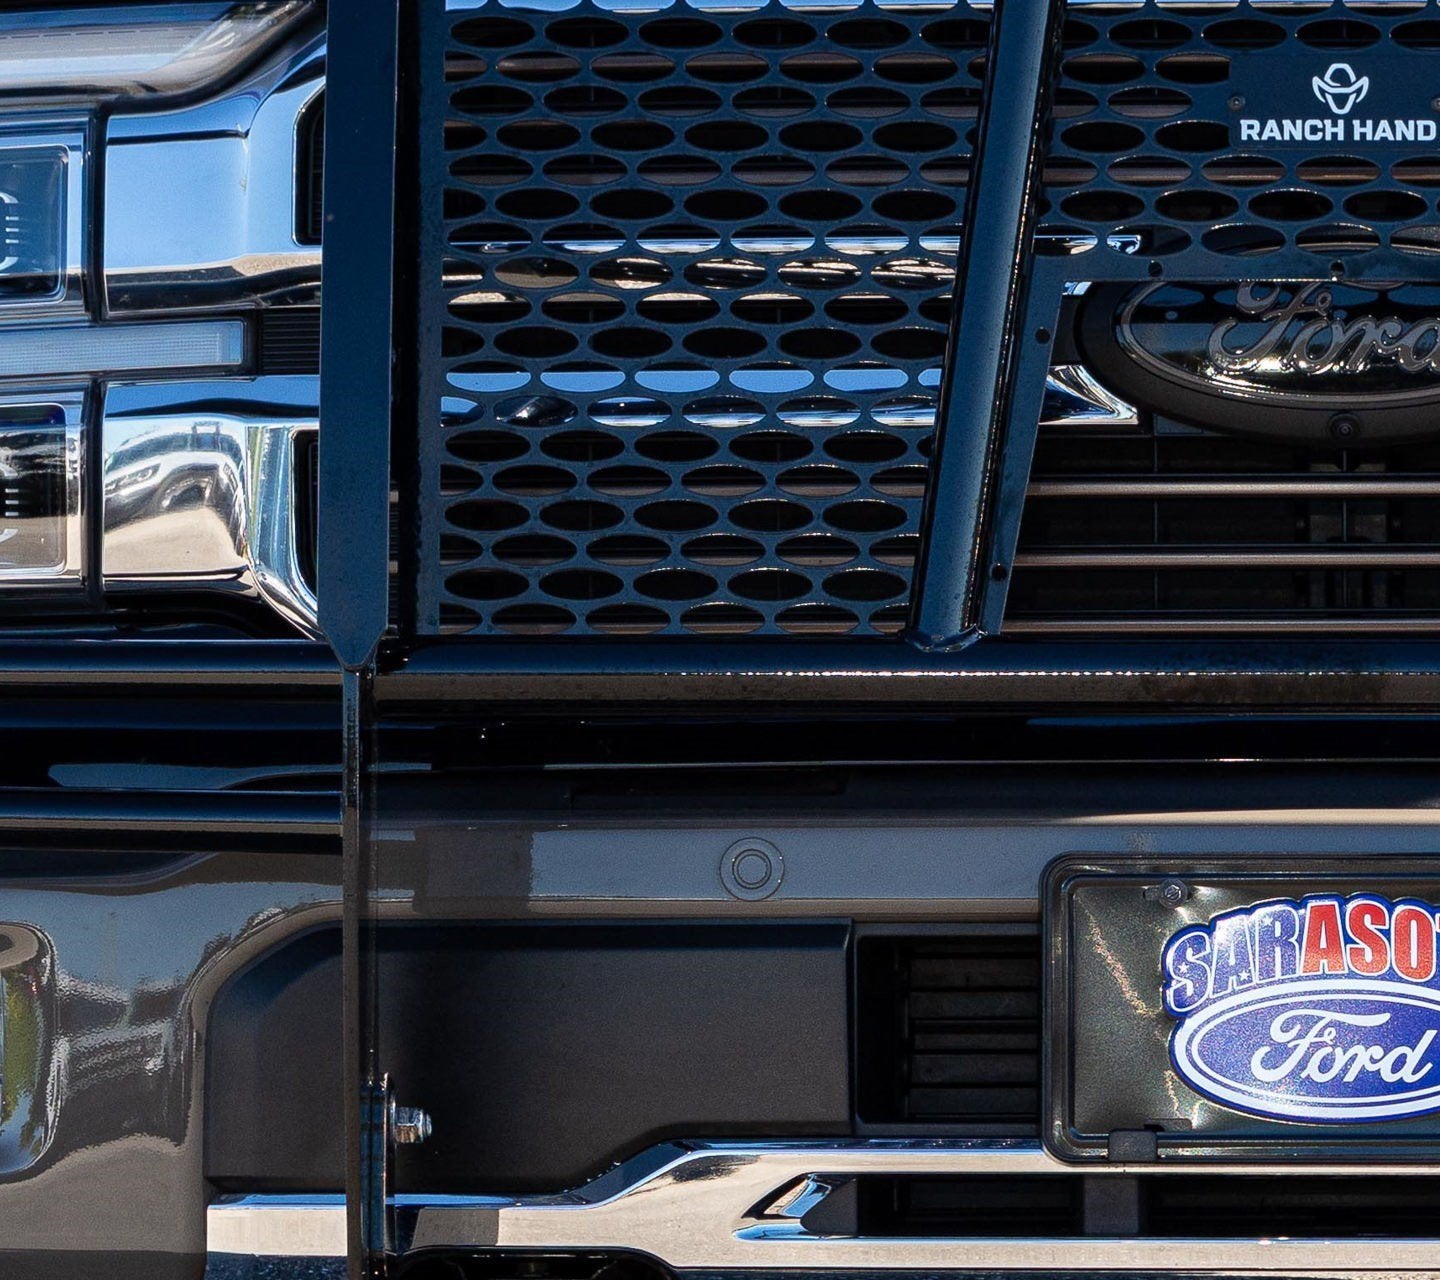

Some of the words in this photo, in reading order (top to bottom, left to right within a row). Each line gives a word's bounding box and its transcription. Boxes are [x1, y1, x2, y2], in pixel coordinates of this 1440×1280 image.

[1240, 118, 1345, 141] RANCH
[1353, 118, 1437, 141] HAND
[1250, 1008, 1439, 1083] Ford
